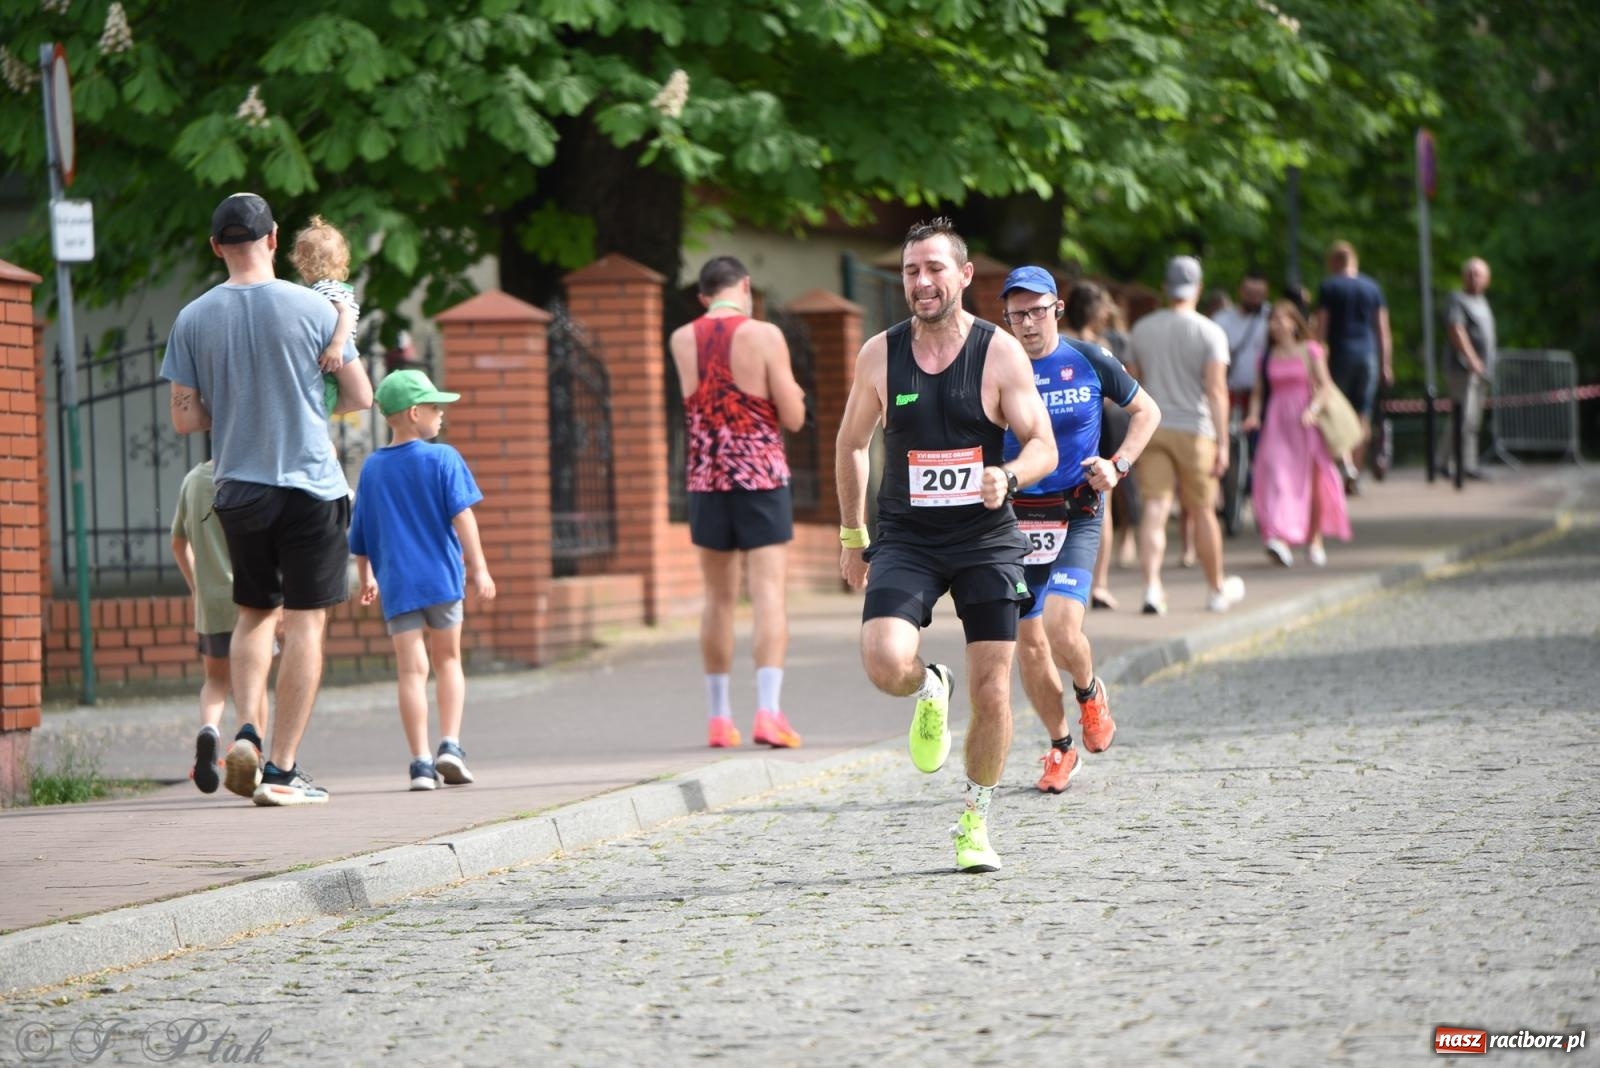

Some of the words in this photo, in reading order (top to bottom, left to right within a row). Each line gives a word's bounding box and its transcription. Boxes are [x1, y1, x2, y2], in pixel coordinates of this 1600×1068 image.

[1050, 406, 1074, 415] TEAM
[922, 467, 972, 491] 207
[1029, 532, 1055, 551] 53
